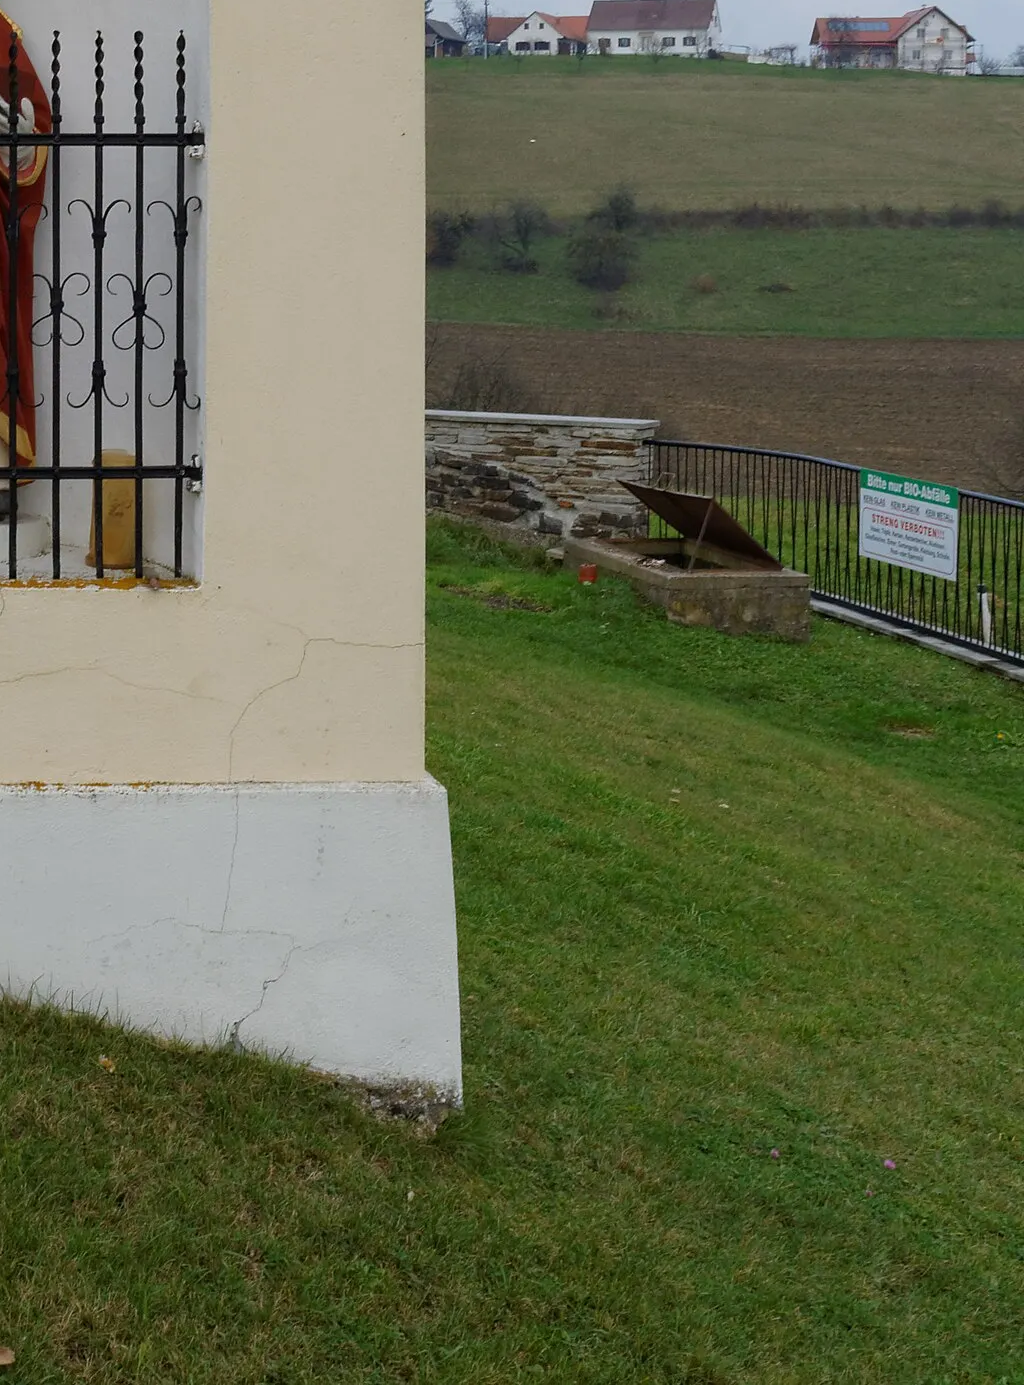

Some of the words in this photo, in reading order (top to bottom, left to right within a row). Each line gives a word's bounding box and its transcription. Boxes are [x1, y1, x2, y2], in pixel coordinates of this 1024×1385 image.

[867, 473, 886, 490] Bitte
[888, 481, 902, 493] nur
[903, 481, 950, 504] BIO-Abfälle
[871, 513, 898, 528] STRENG
[900, 520, 944, 540] VERBOTEN!!!
